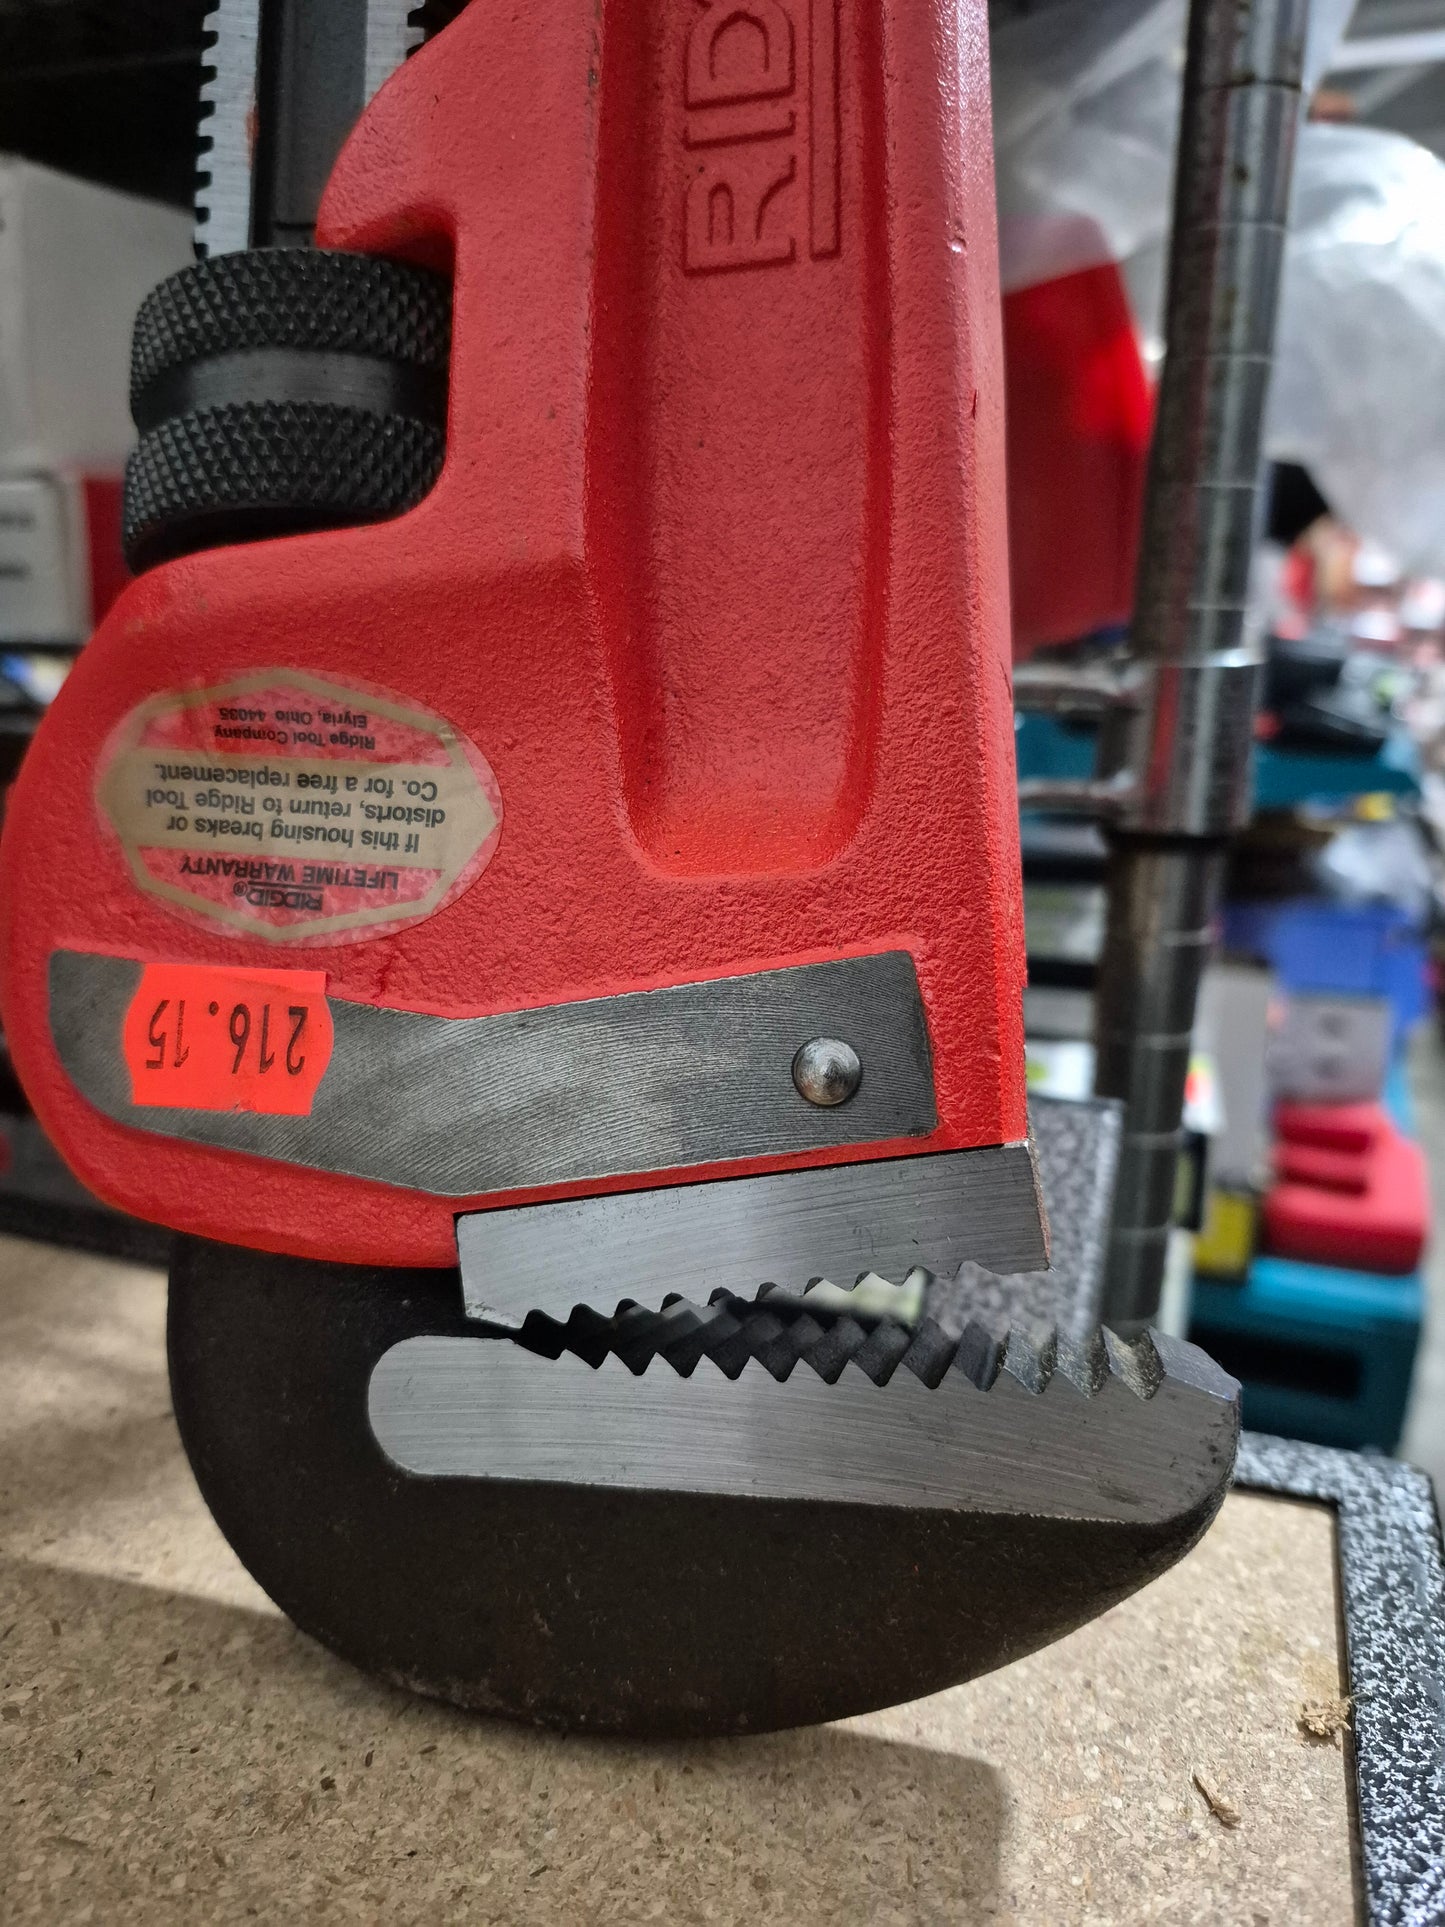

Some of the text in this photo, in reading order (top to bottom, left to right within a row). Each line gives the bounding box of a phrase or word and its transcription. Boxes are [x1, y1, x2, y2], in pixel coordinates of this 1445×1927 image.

[219, 707, 367, 728] Elyria, Ohio 44035
[213, 725, 376, 750] Ridge Tool Company
[154, 763, 438, 801] Co. for a free replacement.
[145, 789, 446, 825] distorts, return to Ridge Tool
[166, 817, 420, 852] If this housing breaks or
[180, 856, 399, 889] LIFETIME WARRANTY
[146, 1000, 309, 1076] 216.15
